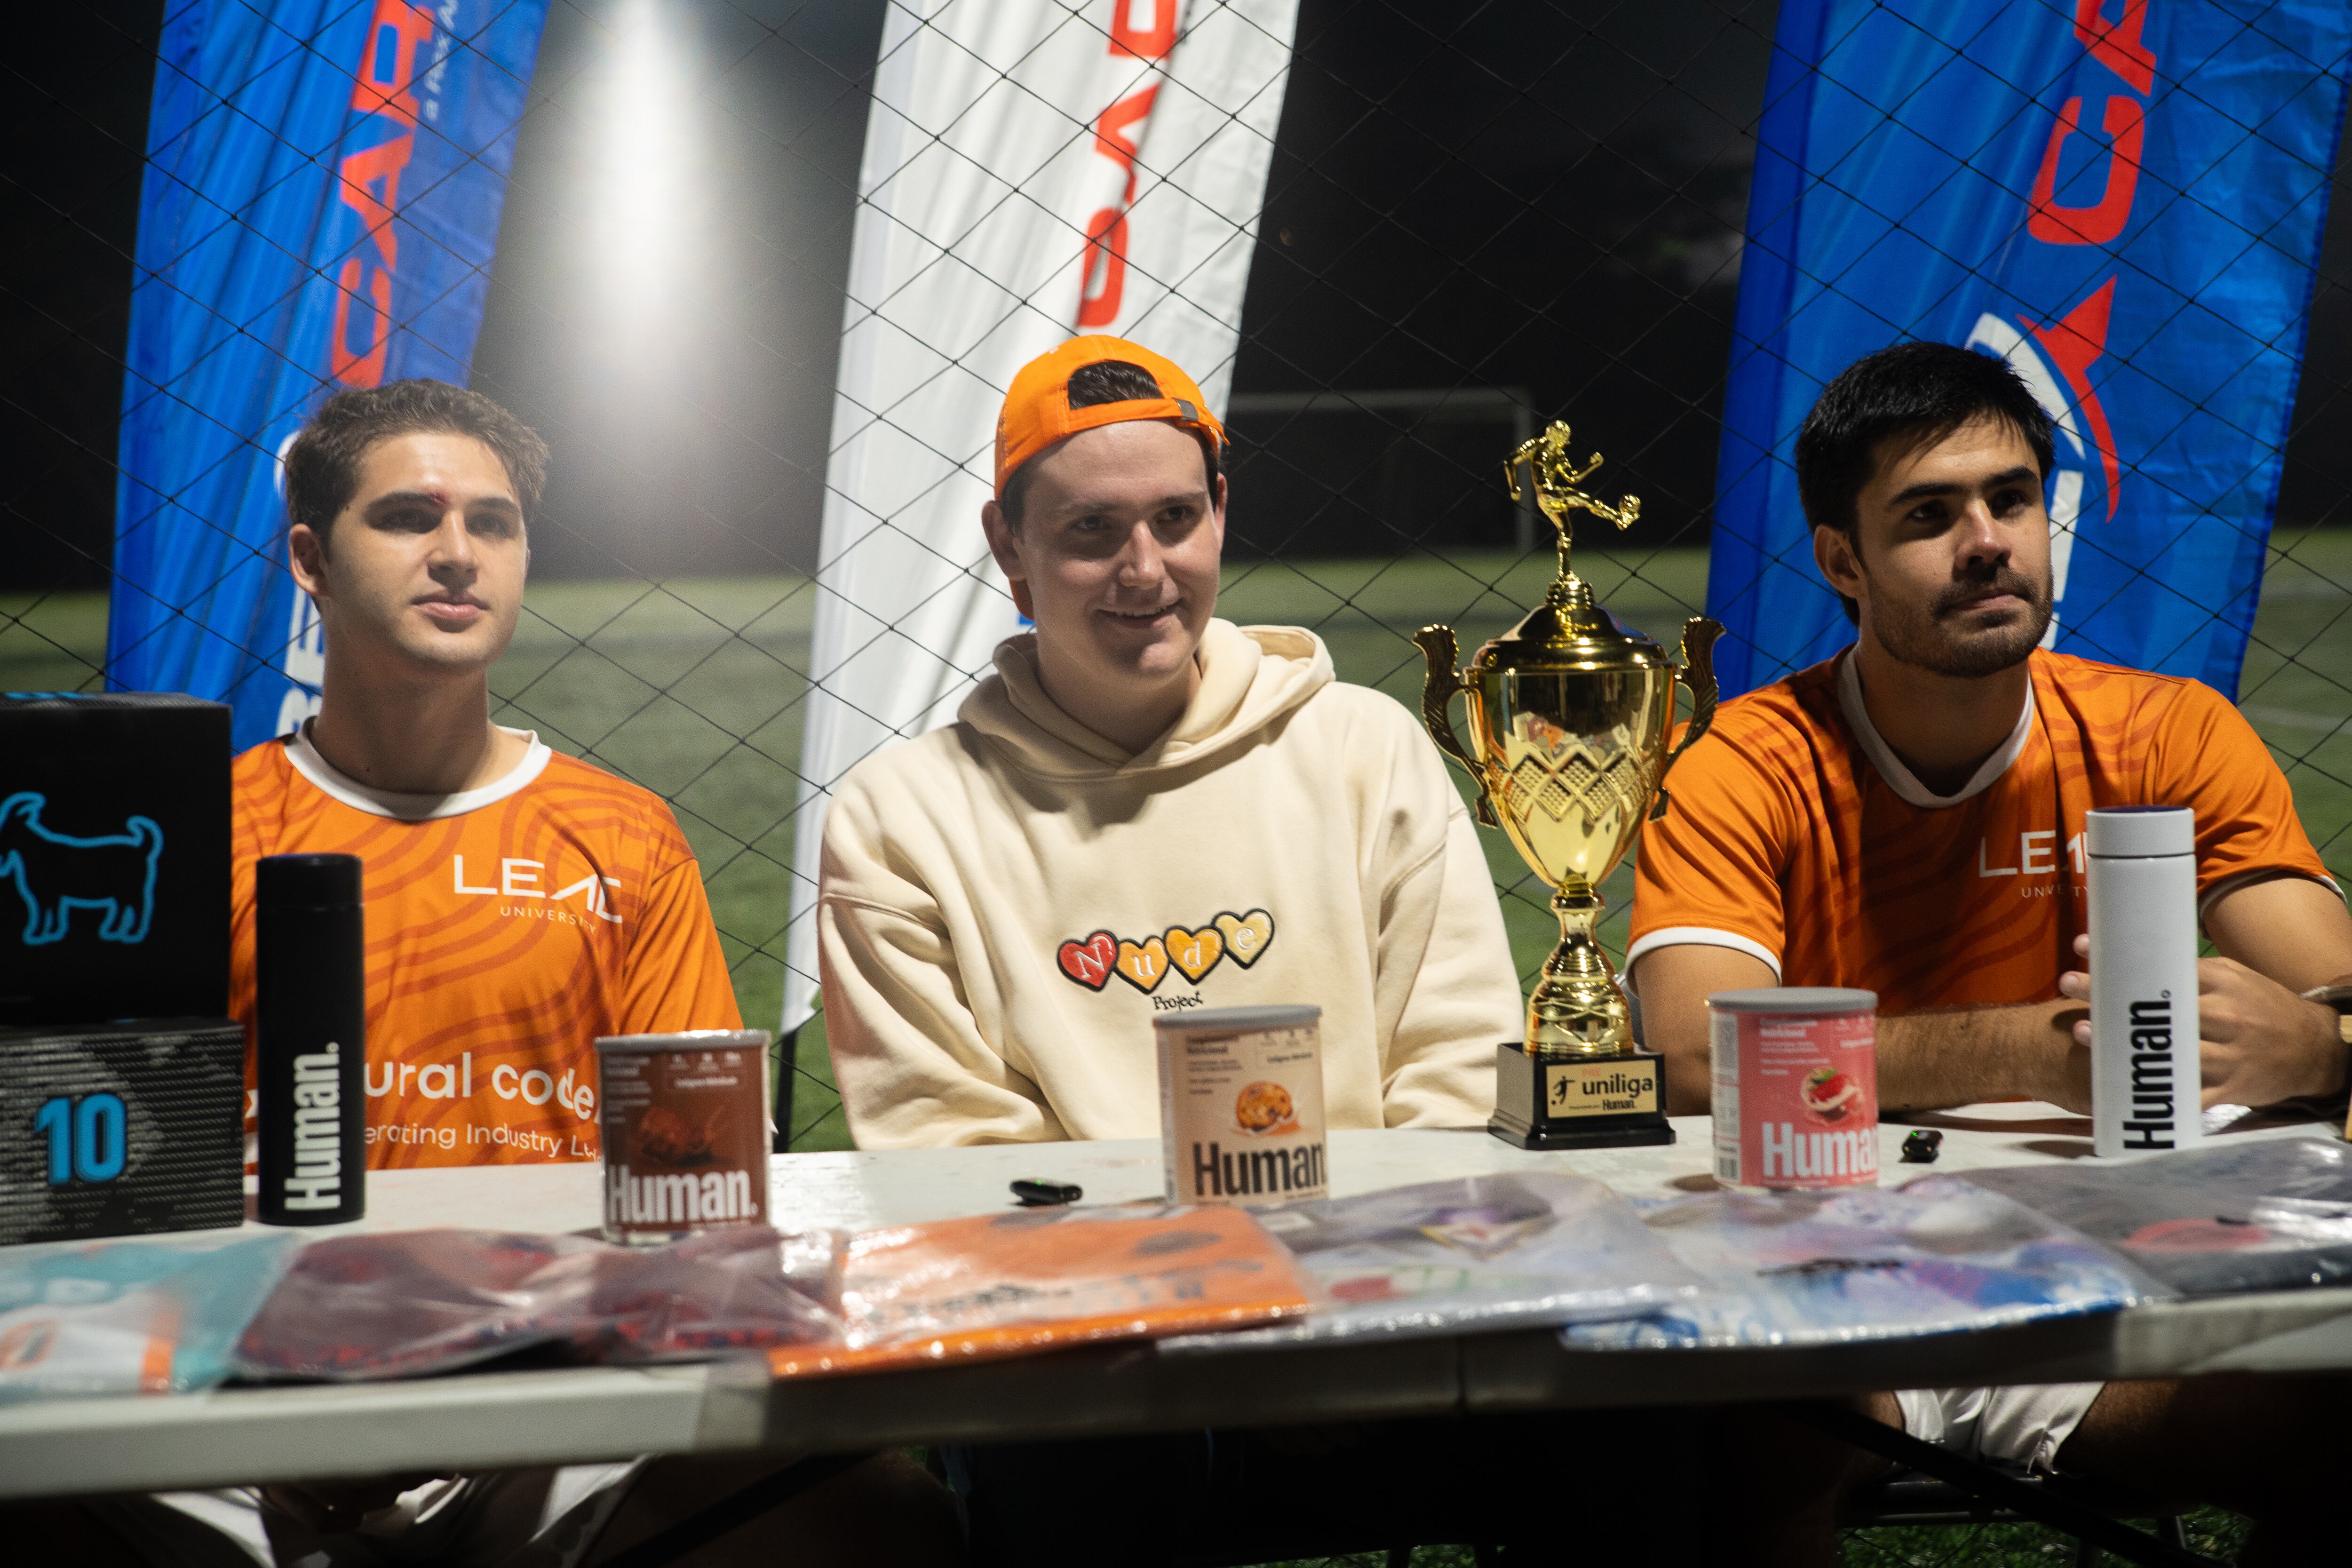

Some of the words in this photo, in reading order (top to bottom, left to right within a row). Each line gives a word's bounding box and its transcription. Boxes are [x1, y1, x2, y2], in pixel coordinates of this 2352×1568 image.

[1979, 830, 2088, 878] LEA
[365, 1052, 471, 1098] ural
[492, 1068, 600, 1123] code
[1582, 1073, 1653, 1098] uniliga
[34, 1093, 127, 1186] 10
[365, 1124, 456, 1149] erating
[467, 1123, 563, 1158] Industry
[1762, 1122, 1878, 1176] Huma
